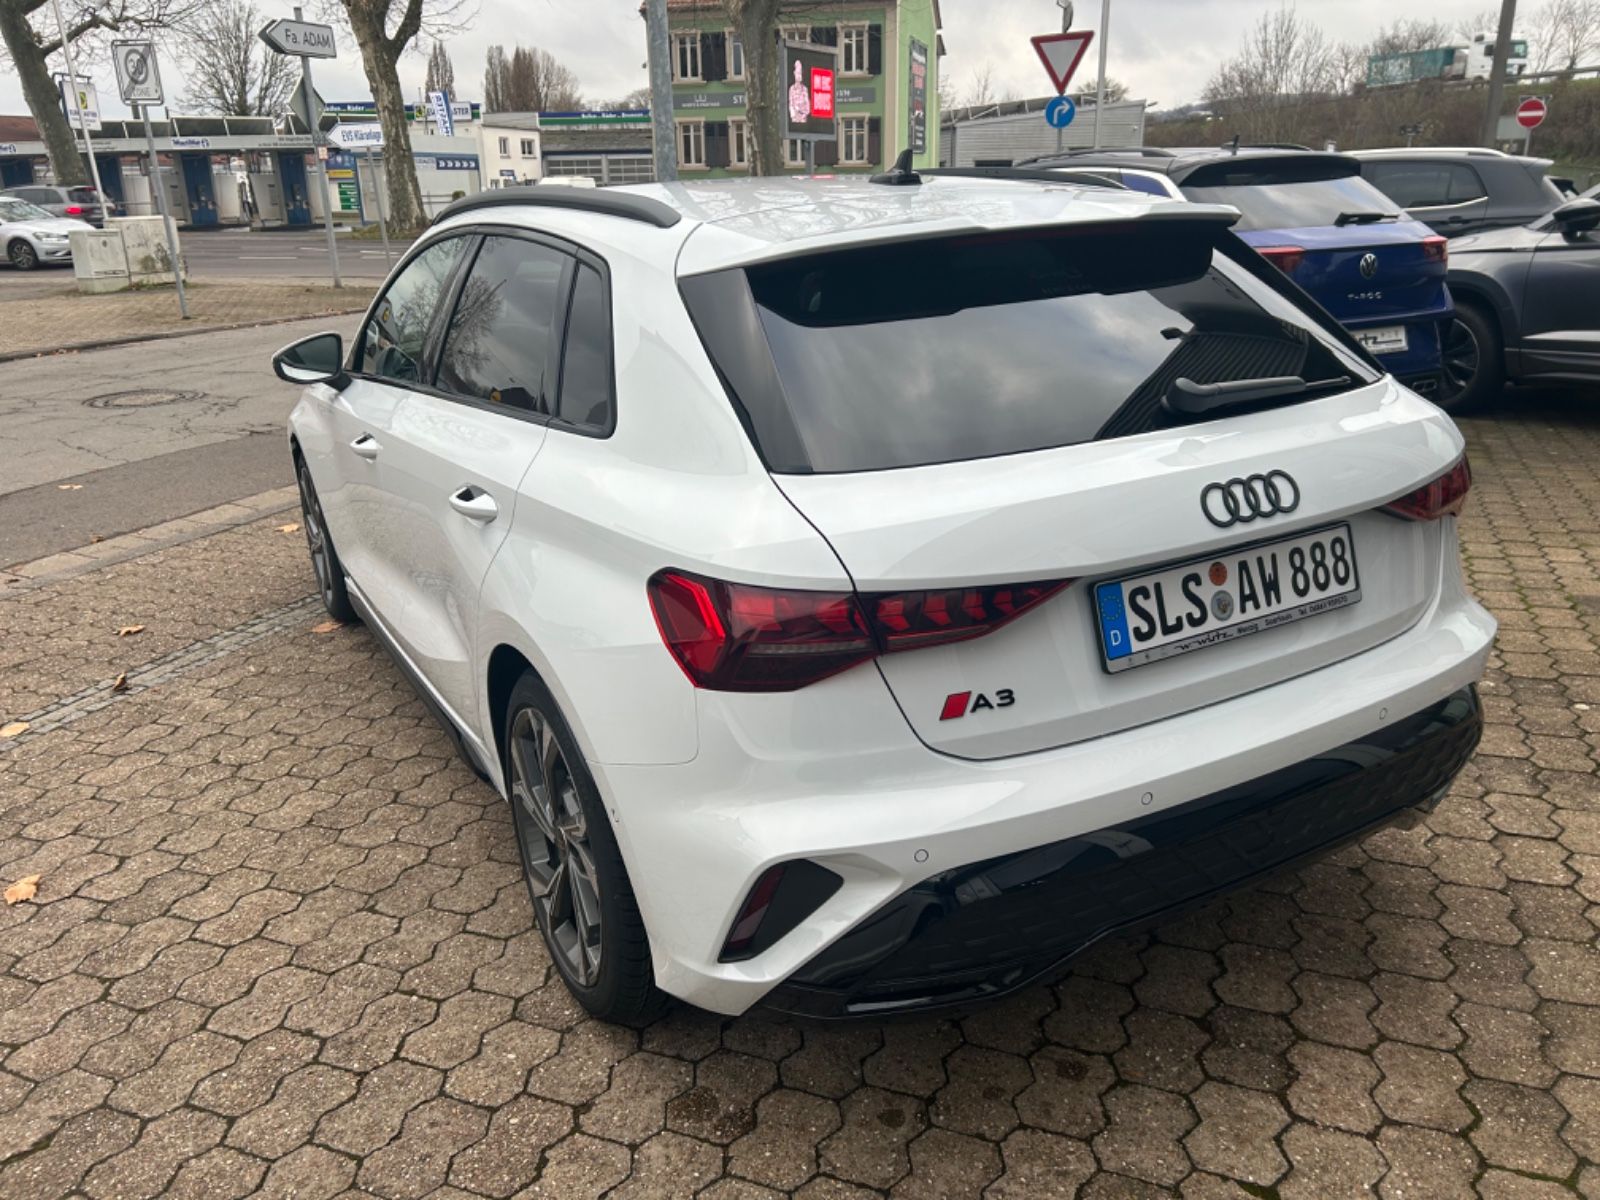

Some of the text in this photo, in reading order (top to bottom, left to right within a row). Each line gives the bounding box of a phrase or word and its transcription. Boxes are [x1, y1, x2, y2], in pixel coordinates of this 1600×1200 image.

[302, 31, 331, 49] ADAM
[1128, 536, 1351, 642] SLS AW 888
[1110, 629, 1122, 647] D
[970, 688, 1016, 714] A3
